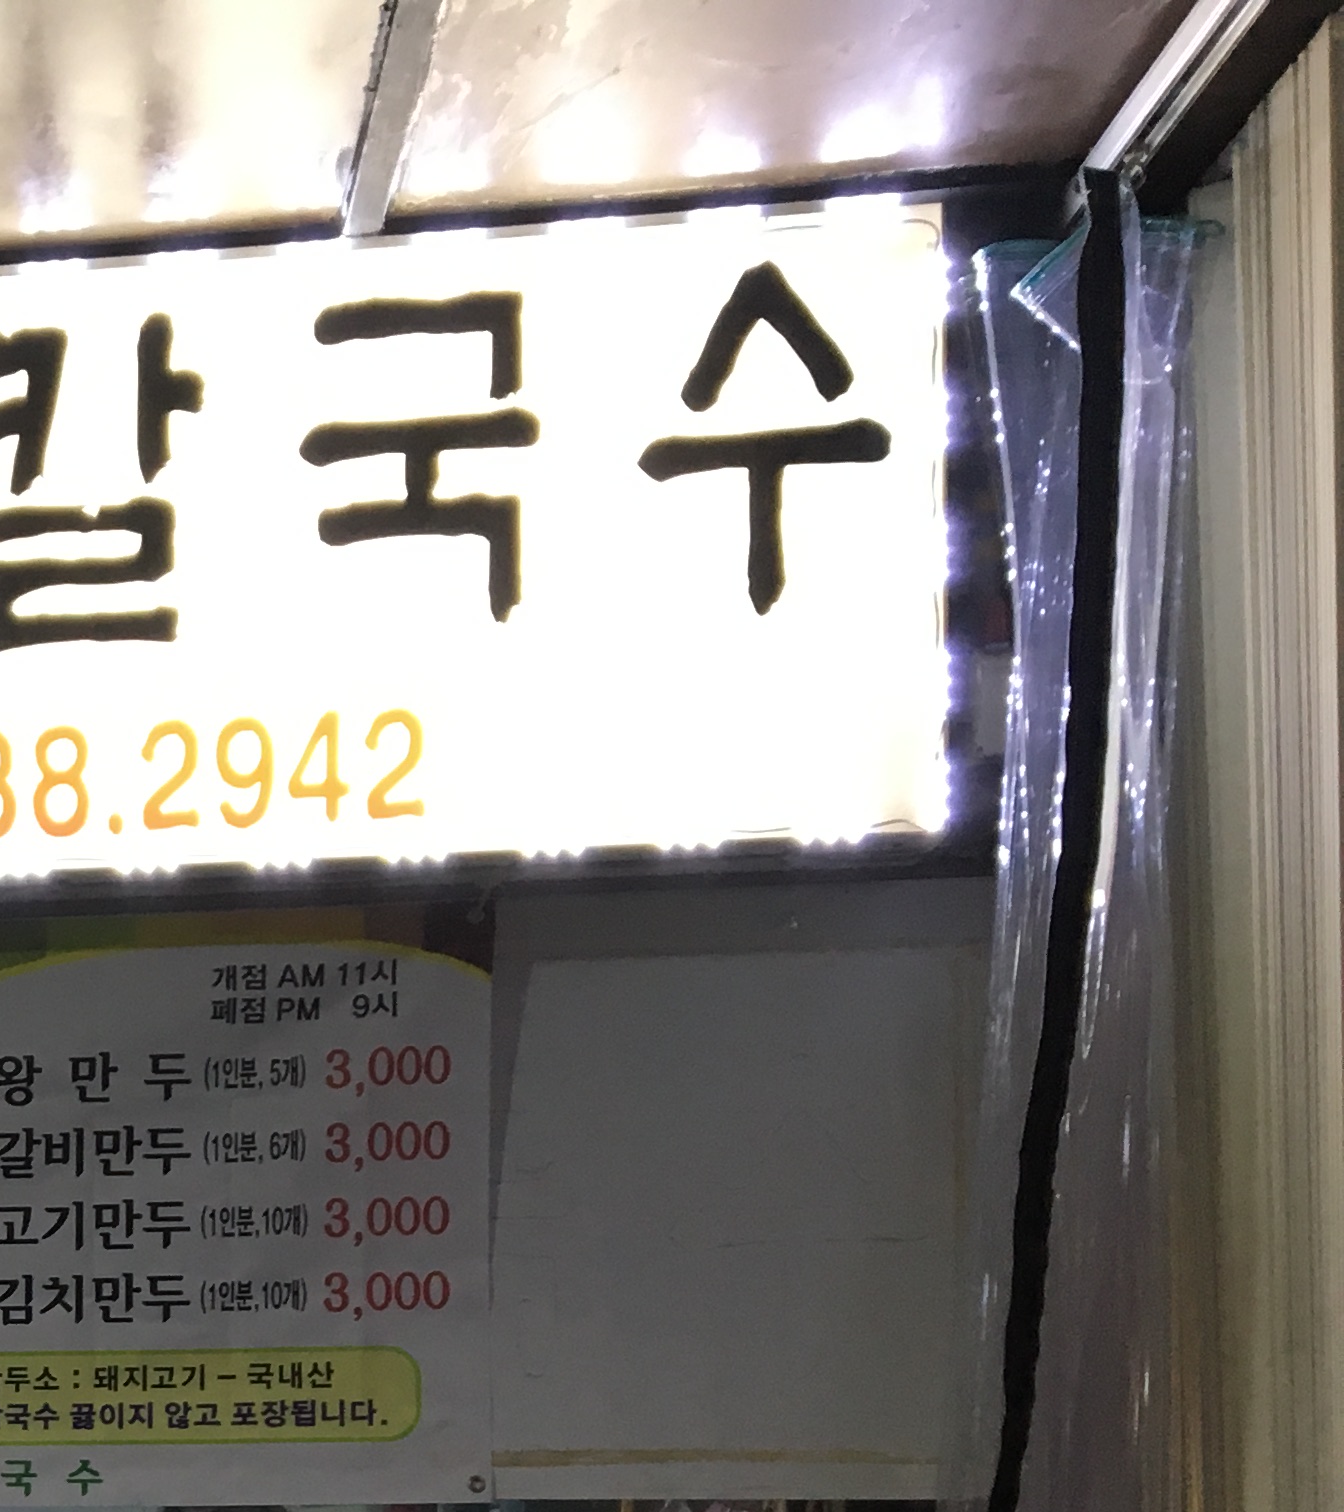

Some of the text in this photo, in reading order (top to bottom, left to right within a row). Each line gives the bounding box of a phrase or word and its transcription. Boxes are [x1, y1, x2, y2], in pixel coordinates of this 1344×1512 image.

[212, 958, 398, 990] 개점 AM 11시
[210, 991, 399, 1024] 폐점 PM 9시
[325, 1044, 451, 1098] 3,000
[325, 1120, 451, 1174] 3,000
[324, 1196, 450, 1248] 3,000
[324, 1270, 451, 1322] 3,000
[93, 1362, 207, 1392] 돼지고기
[247, 1360, 335, 1390] 국내산
[70, 1400, 155, 1431] 끓이지
[165, 1400, 222, 1428] 않고
[231, 1398, 389, 1428] 포장됩니다.
